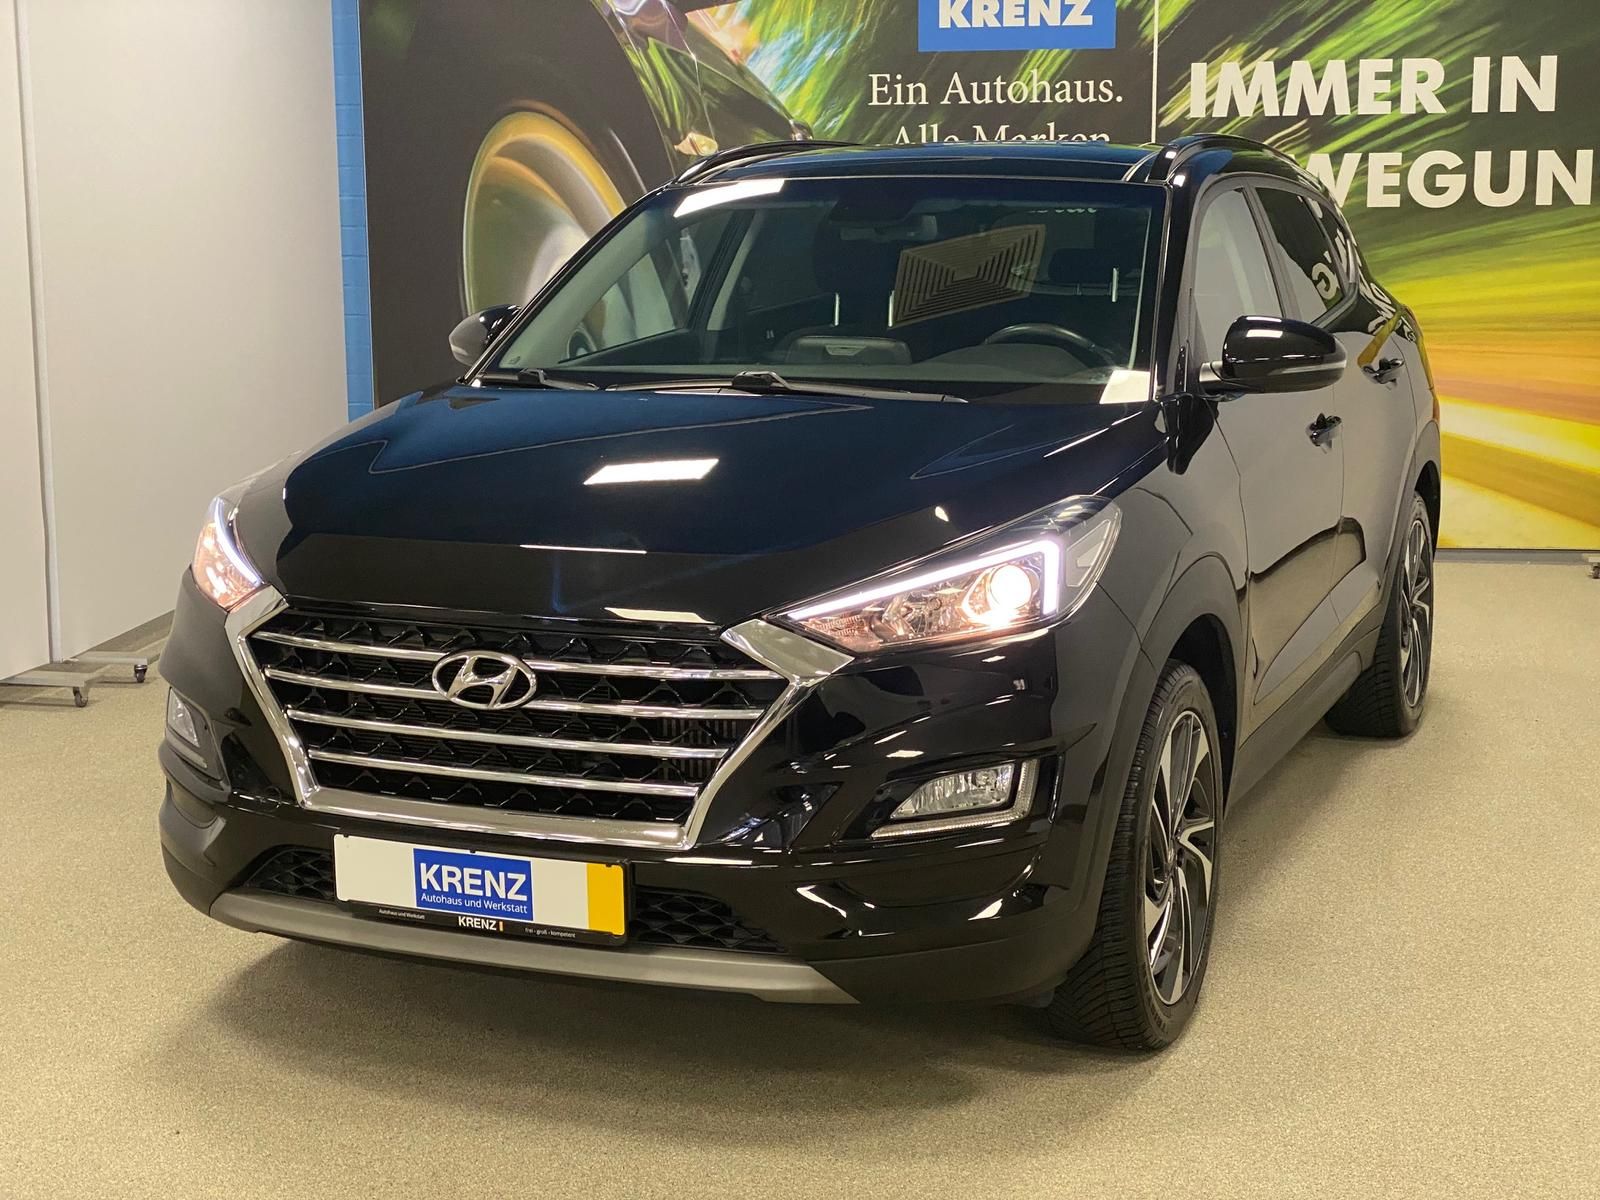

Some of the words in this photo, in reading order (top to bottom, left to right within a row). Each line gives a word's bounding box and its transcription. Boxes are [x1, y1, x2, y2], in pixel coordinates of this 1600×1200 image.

[938, 0, 1093, 28] KRENZ
[868, 73, 928, 106] Ein
[940, 70, 1123, 105] Autohaus.
[1189, 57, 1447, 118] IMMER
[1471, 55, 1558, 114] IN
[420, 863, 528, 901] KRENZ
[421, 893, 462, 906] Autohaus
[464, 899, 481, 908] und
[484, 901, 528, 914] Werkstatt
[458, 916, 497, 931] KRENZ
